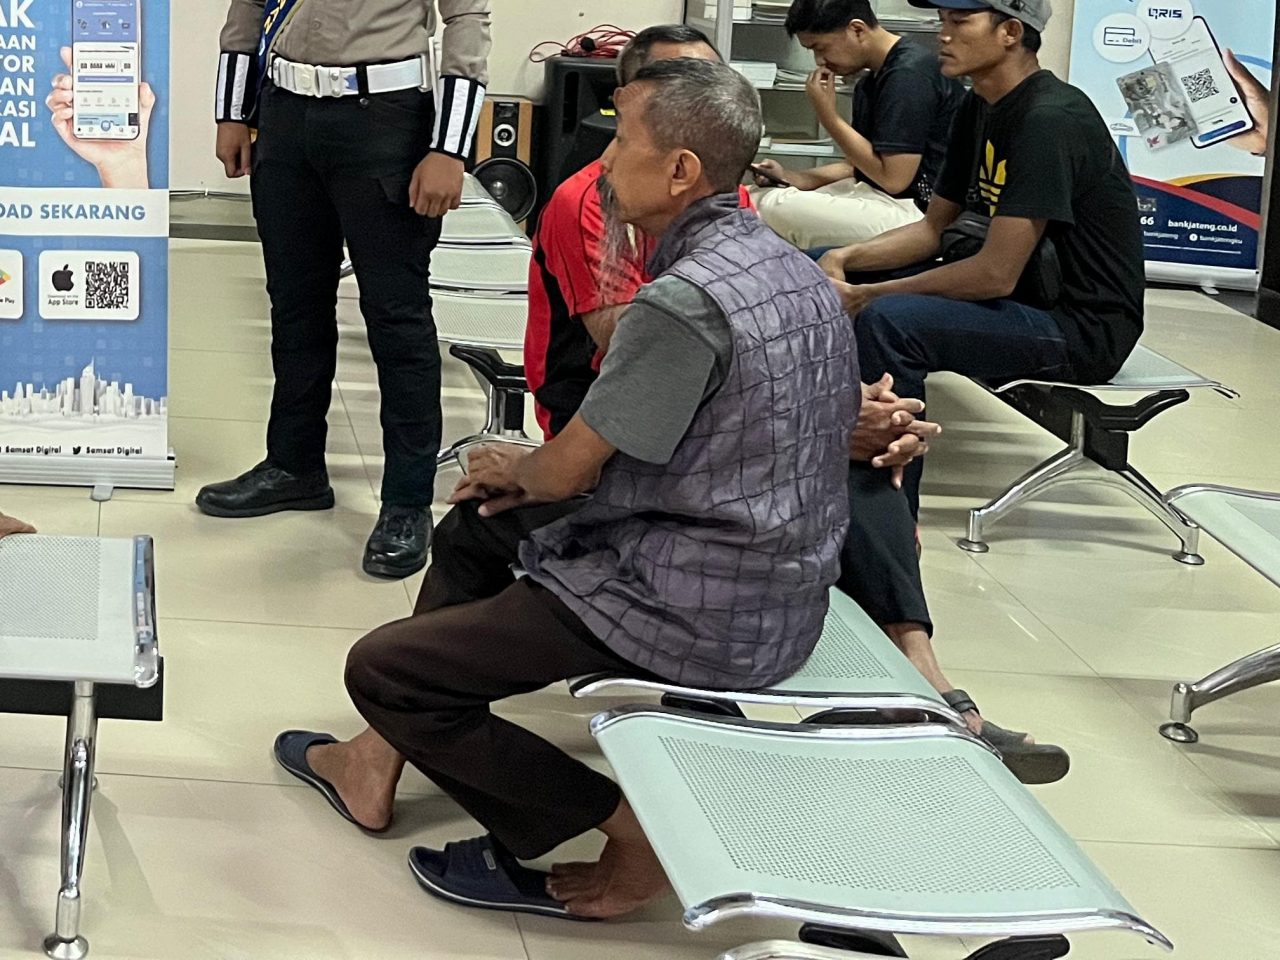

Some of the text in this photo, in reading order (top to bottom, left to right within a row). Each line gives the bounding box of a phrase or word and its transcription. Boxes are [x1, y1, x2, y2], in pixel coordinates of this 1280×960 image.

[1148, 7, 1183, 20] QRIS
[1122, 36, 1142, 45] Debit
[39, 204, 146, 221] SEKARANG
[1168, 219, 1238, 232] bankjateng.co.id
[5, 445, 62, 455] Samsat Digital
[86, 446, 143, 456] Samsat Digital
